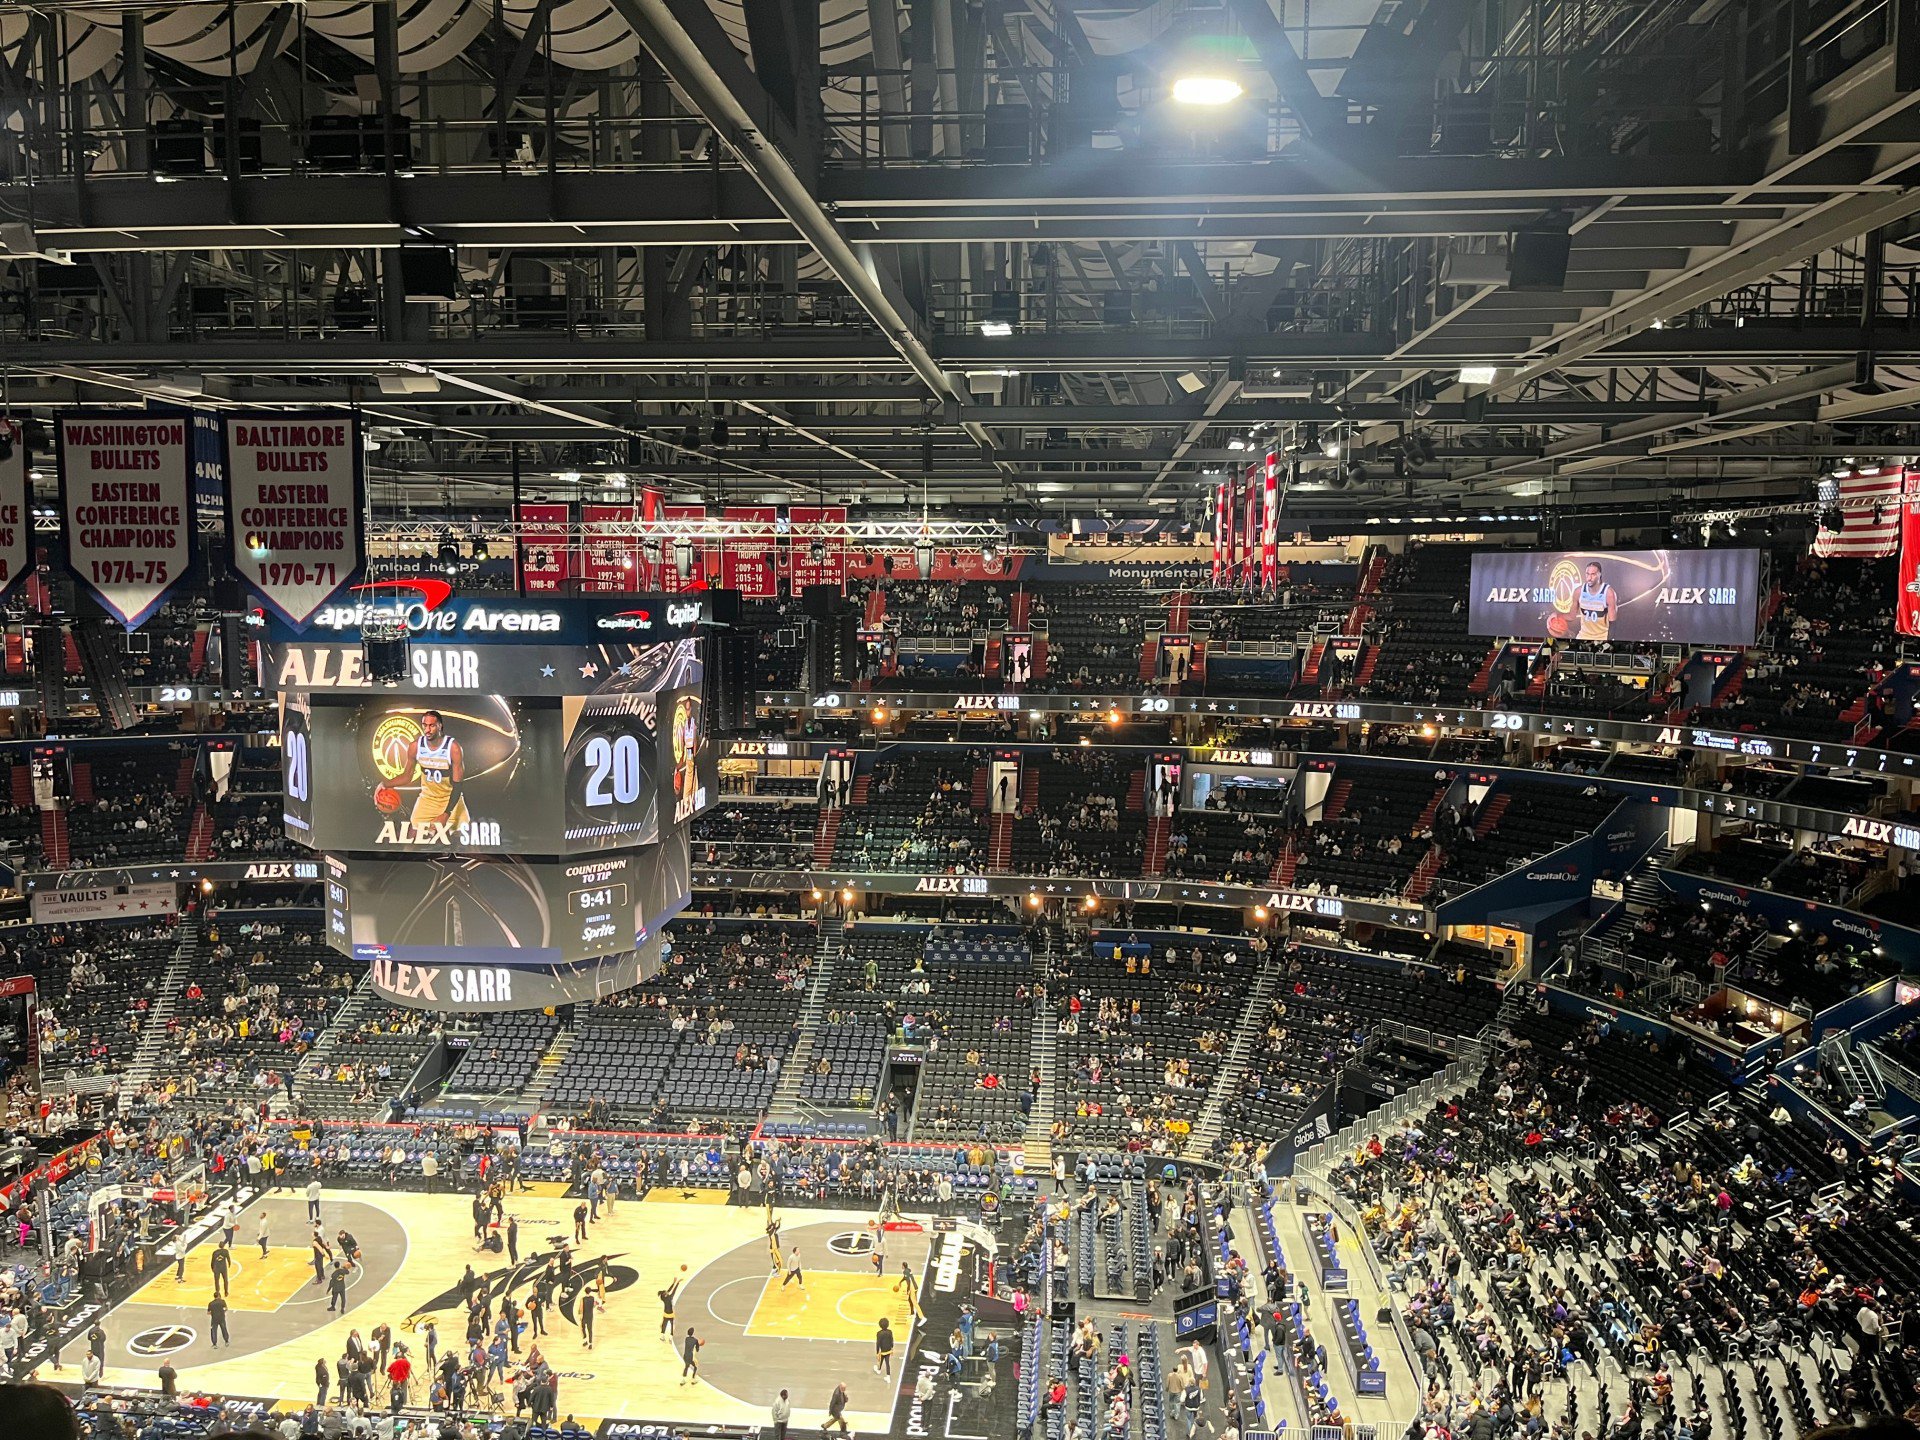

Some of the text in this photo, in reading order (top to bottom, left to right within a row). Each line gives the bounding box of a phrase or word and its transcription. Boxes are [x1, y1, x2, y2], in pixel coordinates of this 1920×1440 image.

[66, 426, 183, 445] WASHINGTON
[236, 426, 345, 446] BALTIMORE
[91, 450, 160, 470] BULLETS
[257, 452, 328, 471] BULLETS
[92, 483, 161, 502] EASTERN
[258, 485, 329, 504] EASTERN
[76, 506, 180, 525] CONFERENCE
[241, 508, 348, 527] CONFERENCE
[80, 529, 176, 548] CHAMPIONS
[245, 531, 344, 550] CHAMPIONS
[92, 561, 168, 584] 1974-75
[259, 563, 336, 585] 1970-71
[1486, 587, 1556, 603] ALEX SARR
[1656, 587, 1736, 604] ALEX SARR
[462, 608, 561, 631] Arena
[412, 649, 479, 689] SARR
[159, 688, 192, 701] 20
[954, 696, 1020, 709] ALEX SARR
[1140, 699, 1169, 712] 20
[1289, 703, 1360, 719] ALEX SARR
[1490, 713, 1523, 729] 20
[729, 743, 788, 755] ALEX SARR
[1210, 750, 1273, 765] ALEX SARR
[1741, 742, 1772, 756] $3,190
[287, 730, 307, 802] 20
[584, 735, 640, 807] 20
[424, 769, 443, 784] 20
[375, 821, 501, 846] ALEX SARR
[1841, 817, 1920, 851] ALEX SARR
[244, 863, 318, 879] ALEX SARR
[565, 859, 627, 877] COUNTDOWN
[582, 871, 612, 884] TO TIP
[1526, 872, 1580, 881] CapitalOne
[915, 878, 988, 893] ALEX SARR
[60, 890, 107, 903] VAULTS
[580, 888, 612, 909] 9:41
[1266, 893, 1344, 916] ALEX SARR
[1698, 887, 1749, 908] CapitalOne
[581, 924, 616, 942] Sprite
[1832, 919, 1882, 942] CapitalOne
[373, 959, 512, 1003] ALEX SARR
[1294, 1129, 1315, 1148] Globe
